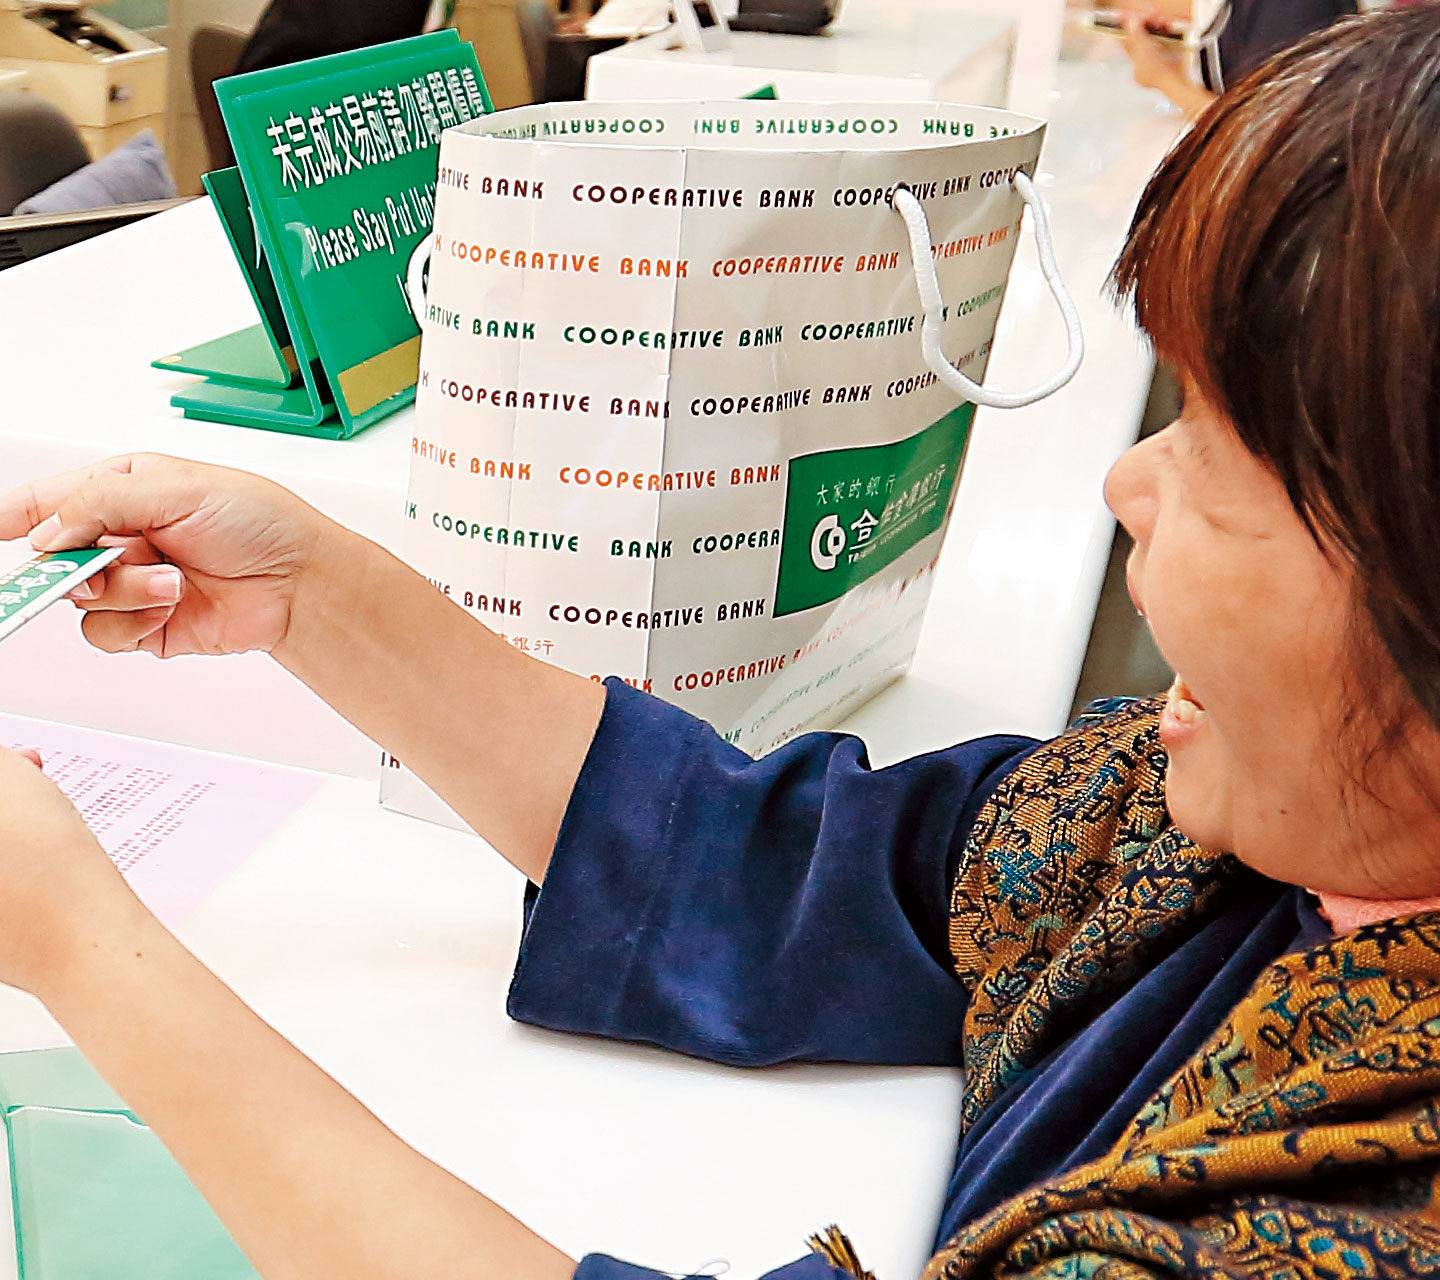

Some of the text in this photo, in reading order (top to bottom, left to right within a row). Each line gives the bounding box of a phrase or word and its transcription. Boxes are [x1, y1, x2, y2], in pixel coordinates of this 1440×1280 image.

[755, 119, 898, 134] COOPERATIVE
[923, 119, 973, 138] BANK
[481, 176, 544, 200] BANK
[572, 184, 743, 208] COOPERATIVE
[759, 189, 815, 208] BANK
[833, 181, 936, 208] COOPETIVE
[942, 174, 972, 197] BANK
[305, 181, 436, 271] Please Stay Put Unt
[451, 240, 600, 274] COOPERATIVE
[619, 257, 689, 278] BANK
[712, 256, 845, 277] COOPERATIVE
[855, 252, 899, 272] BANK
[425, 303, 460, 330] ATIVE
[472, 319, 536, 340] BANK
[563, 326, 724, 349] COOPERATIVE
[738, 326, 783, 347] BANK
[801, 315, 915, 341] COOPERATIVE
[440, 378, 591, 413] COOPERATIVE
[690, 388, 811, 417] COOPERATIVE
[822, 384, 872, 404] BANK
[412, 437, 781, 492] RATIVE BANK COOPERATIVE BANK
[432, 511, 579, 553] COOPERATIVE
[610, 539, 673, 559] BANK
[692, 529, 780, 555] COOPERA
[464, 591, 766, 630] BANK COOPERATIVE BANK
[498, 632, 555, 656] 銀行
[673, 654, 786, 693] COOPERATIVE
